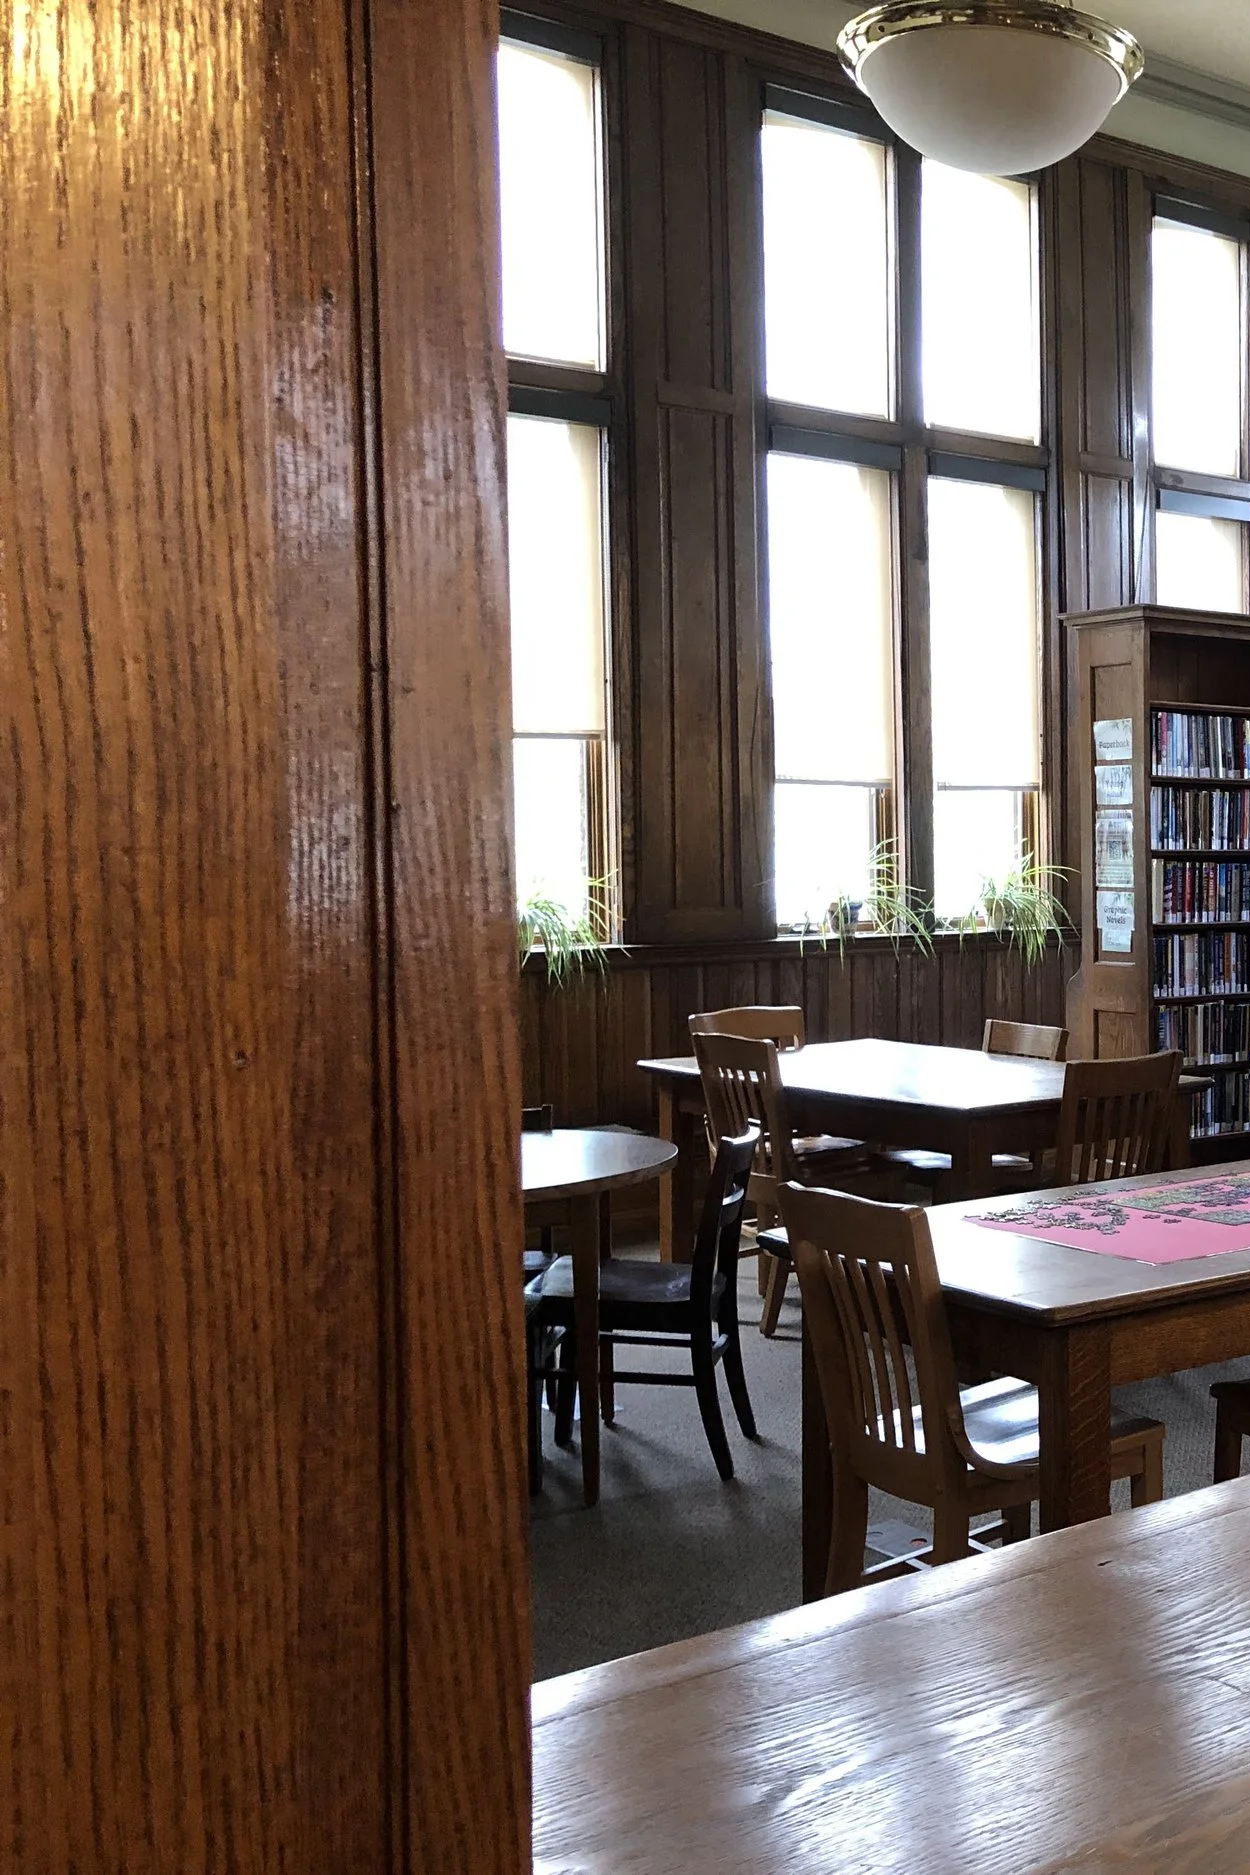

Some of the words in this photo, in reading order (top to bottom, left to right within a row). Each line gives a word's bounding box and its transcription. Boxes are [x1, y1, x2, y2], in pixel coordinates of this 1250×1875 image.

[1099, 739, 1129, 750] Paperback
[1104, 905, 1127, 916] Graphic
[1106, 915, 1126, 925] Novels
